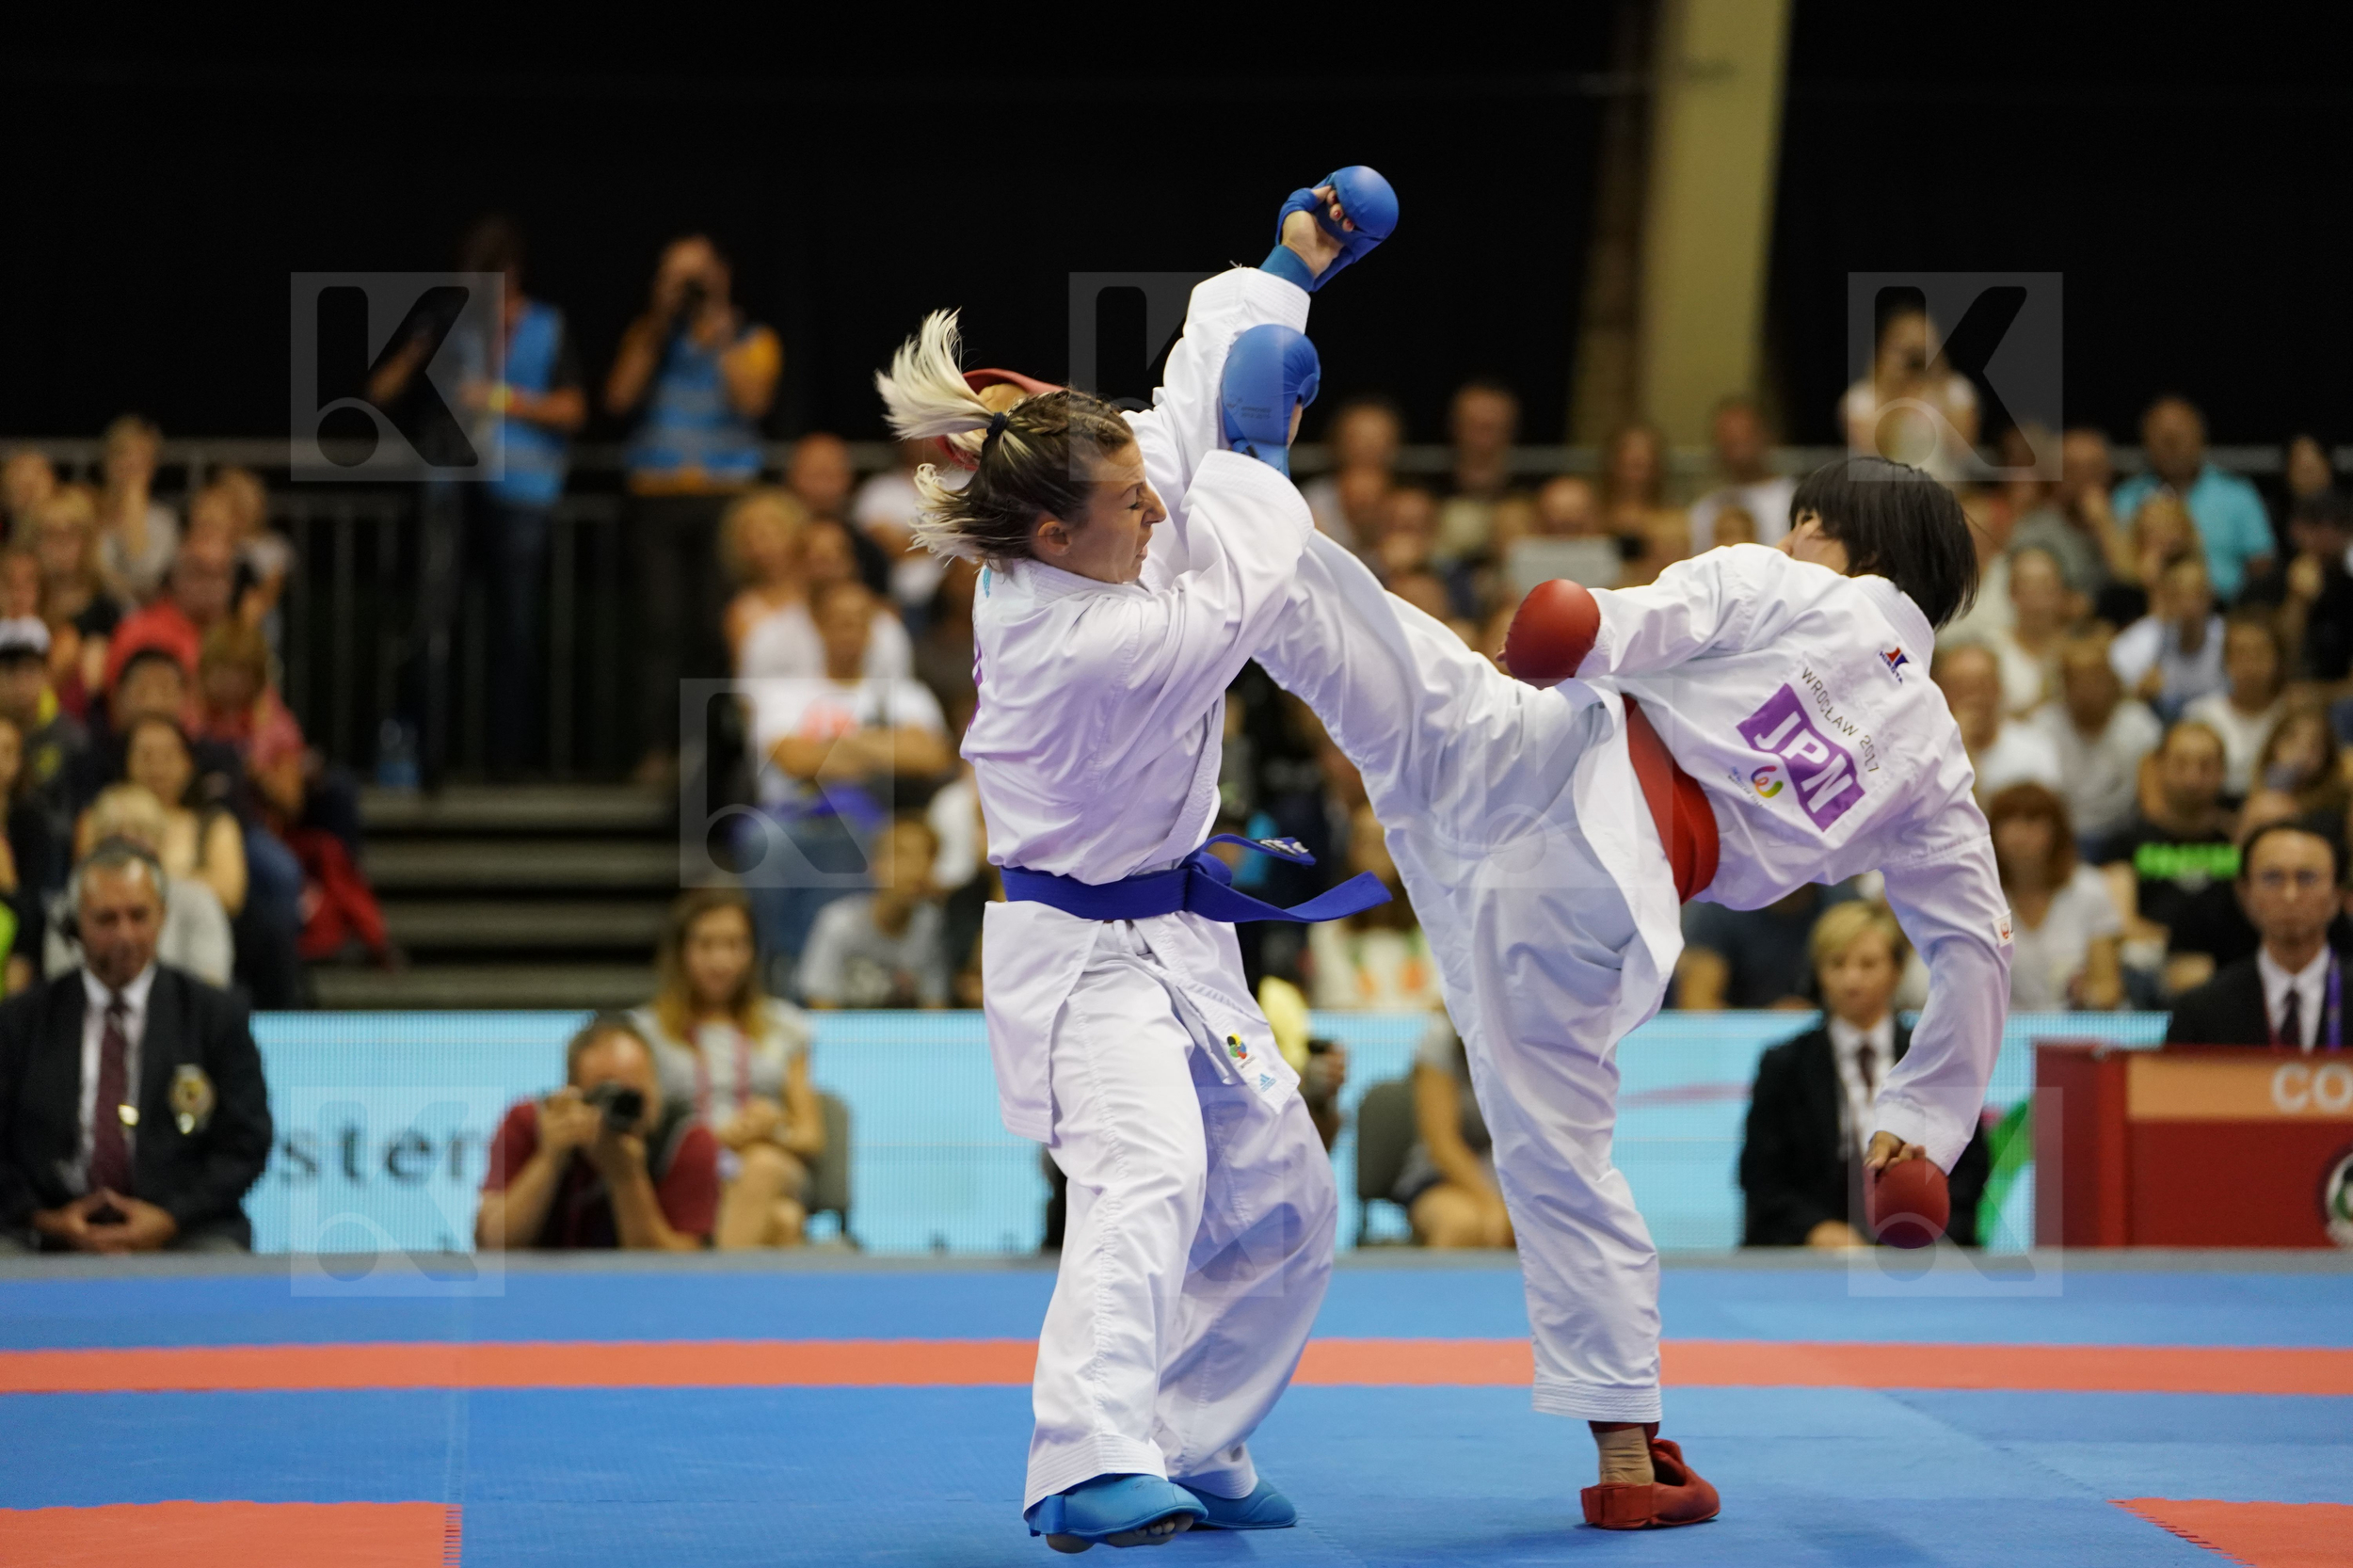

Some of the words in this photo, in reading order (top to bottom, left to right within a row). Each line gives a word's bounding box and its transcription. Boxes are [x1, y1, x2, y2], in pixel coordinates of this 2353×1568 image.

[1753, 711, 1854, 814] JPN
[1859, 734, 1880, 773] 2017
[2270, 1063, 2353, 1114] CO
